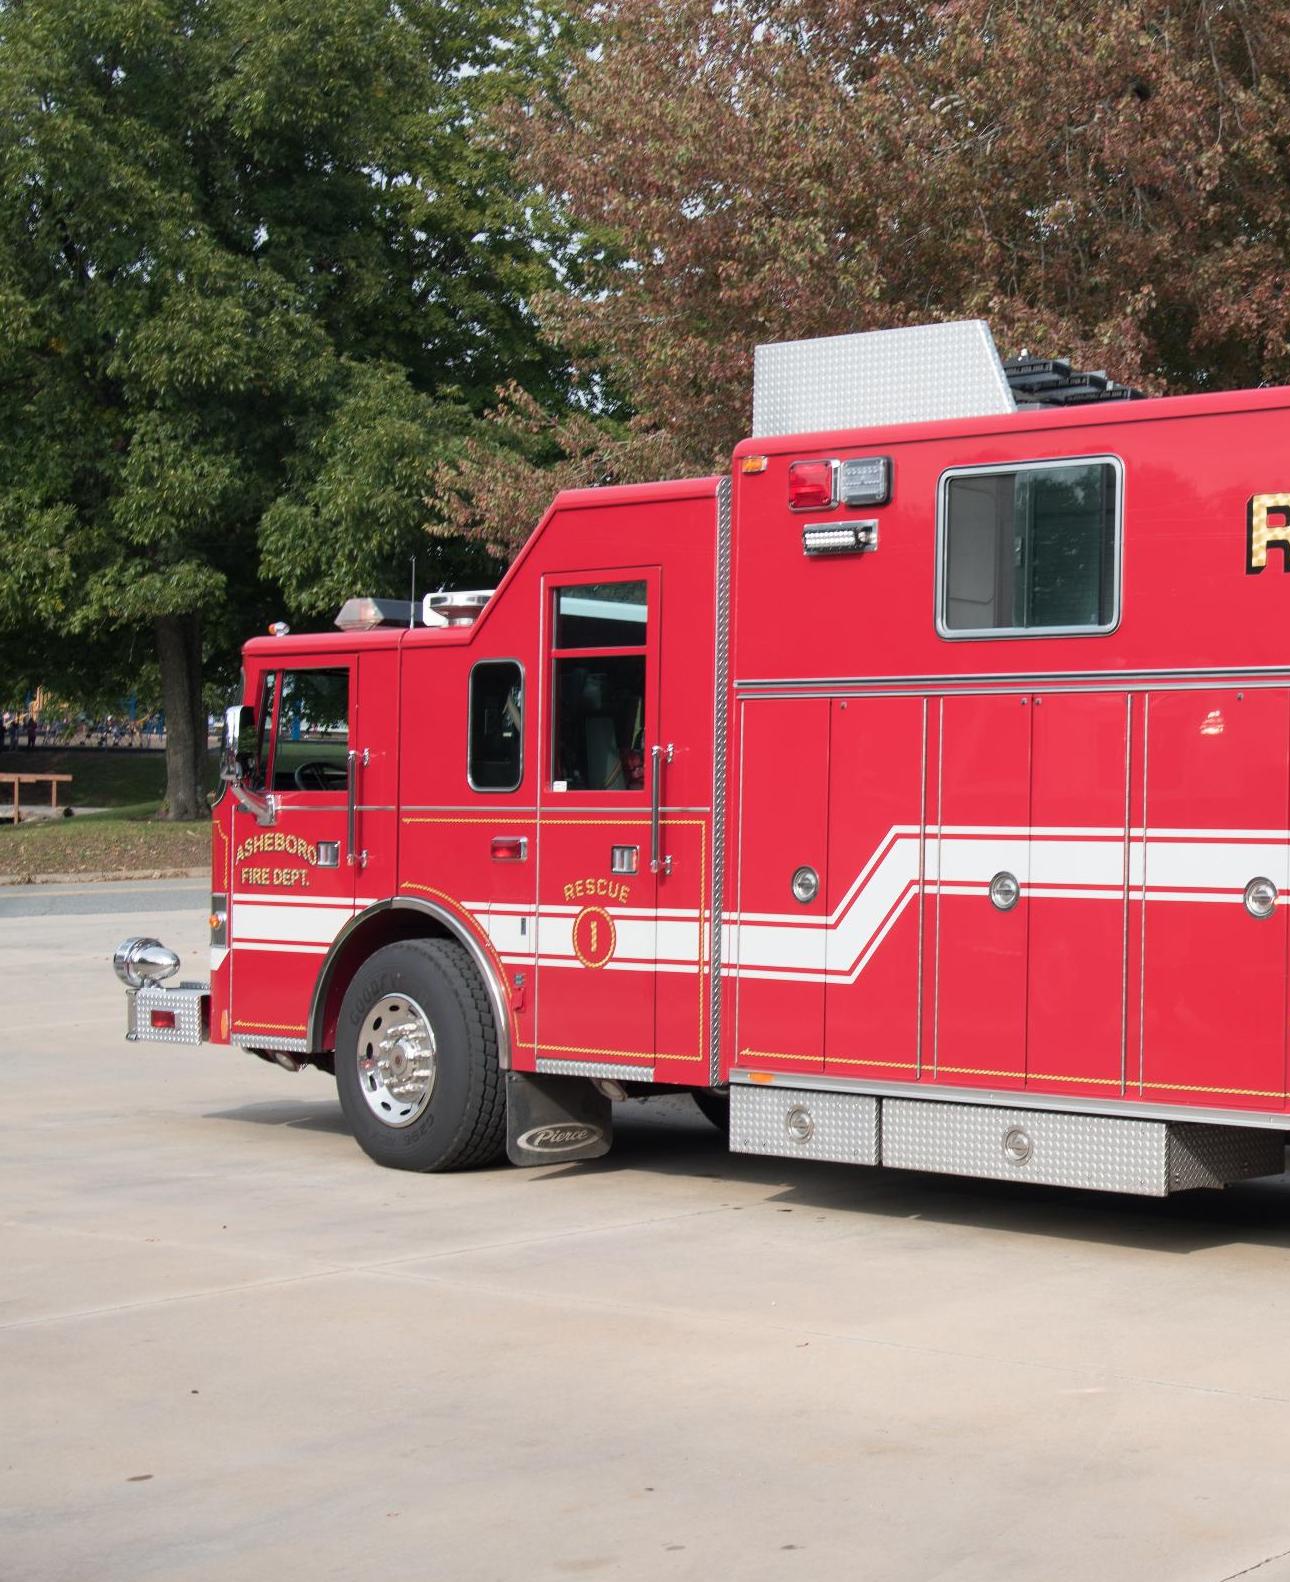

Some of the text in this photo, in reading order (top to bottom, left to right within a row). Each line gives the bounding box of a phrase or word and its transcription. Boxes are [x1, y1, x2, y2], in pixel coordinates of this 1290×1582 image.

[235, 832, 317, 866] ASHEBORO
[241, 867, 310, 886] FIRE DEPT.
[563, 878, 631, 904] RESCUE
[533, 1128, 589, 1147] Pierce
